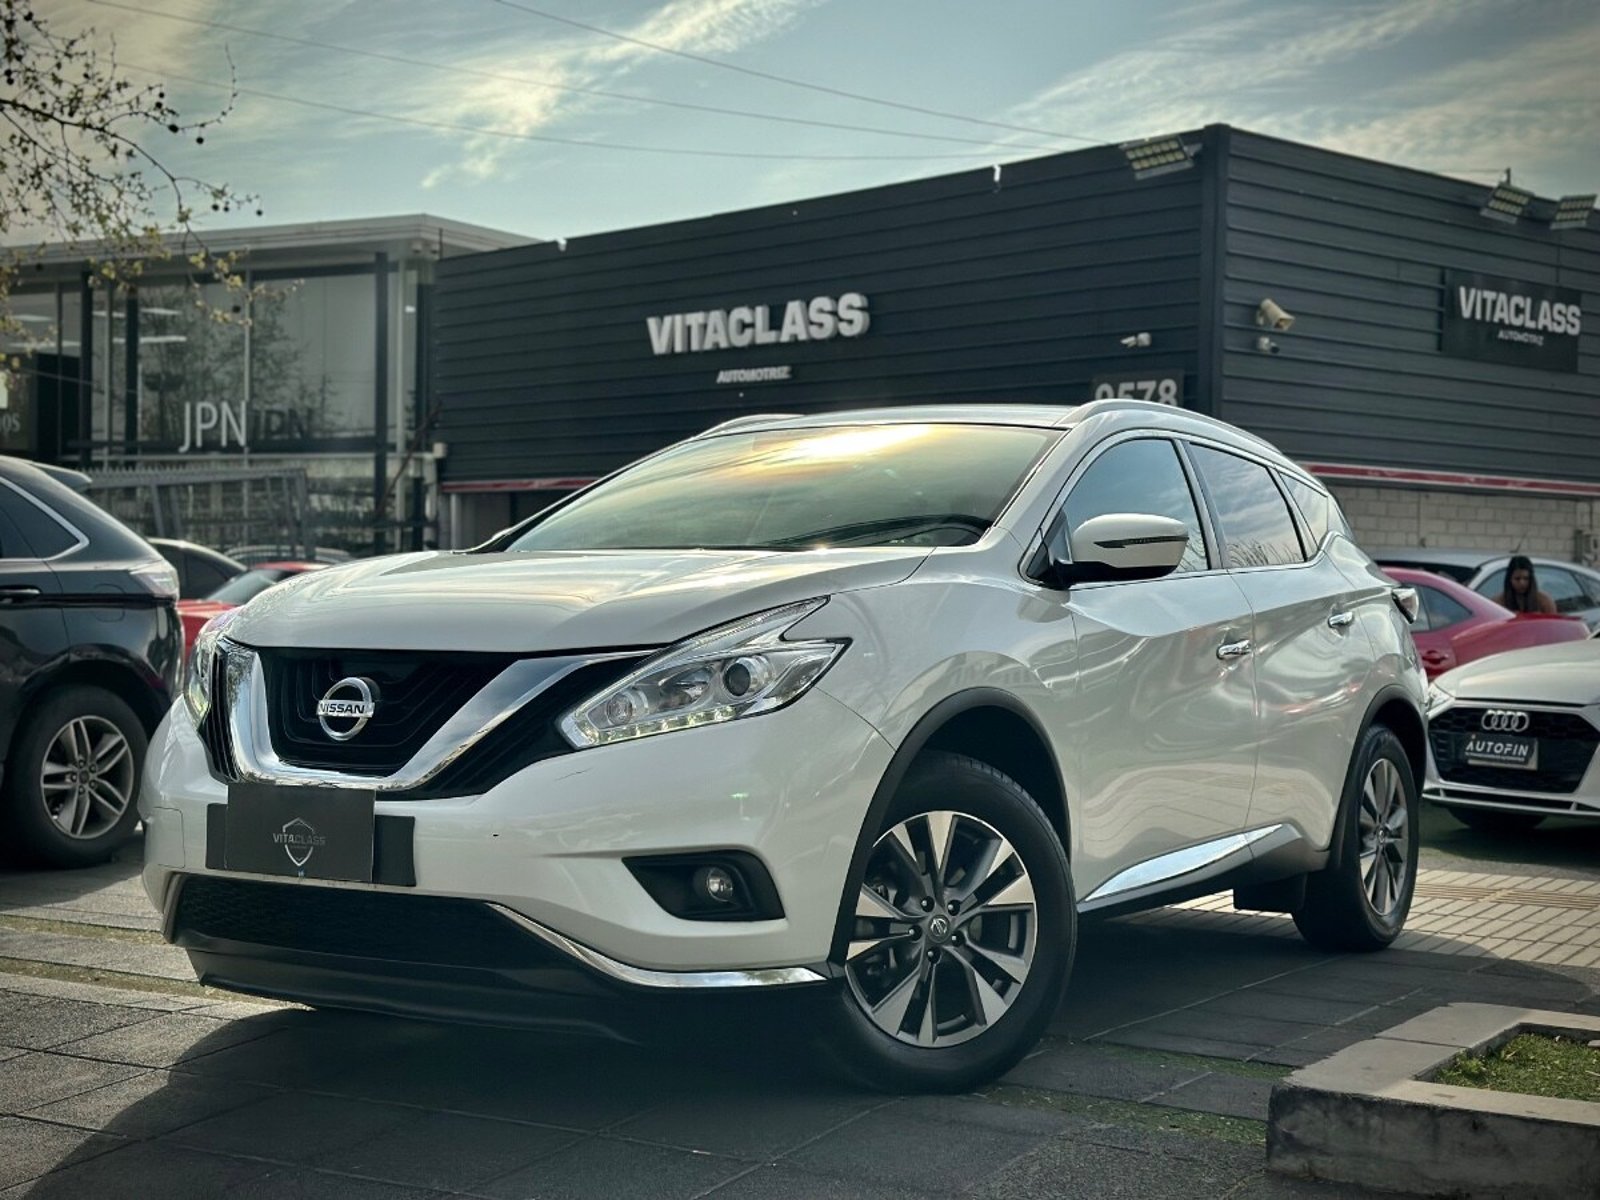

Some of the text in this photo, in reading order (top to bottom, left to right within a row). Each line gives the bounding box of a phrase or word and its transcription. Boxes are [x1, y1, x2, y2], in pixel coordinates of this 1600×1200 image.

[1459, 286, 1582, 336] VITACLASS
[646, 292, 870, 356] VITACLASS
[716, 365, 792, 384] AUTOMOTRIZ
[178, 401, 247, 453] JPN
[319, 702, 365, 714] NISSAN
[1466, 741, 1529, 756] AUTOFIN
[272, 832, 326, 846] VITACLASS
